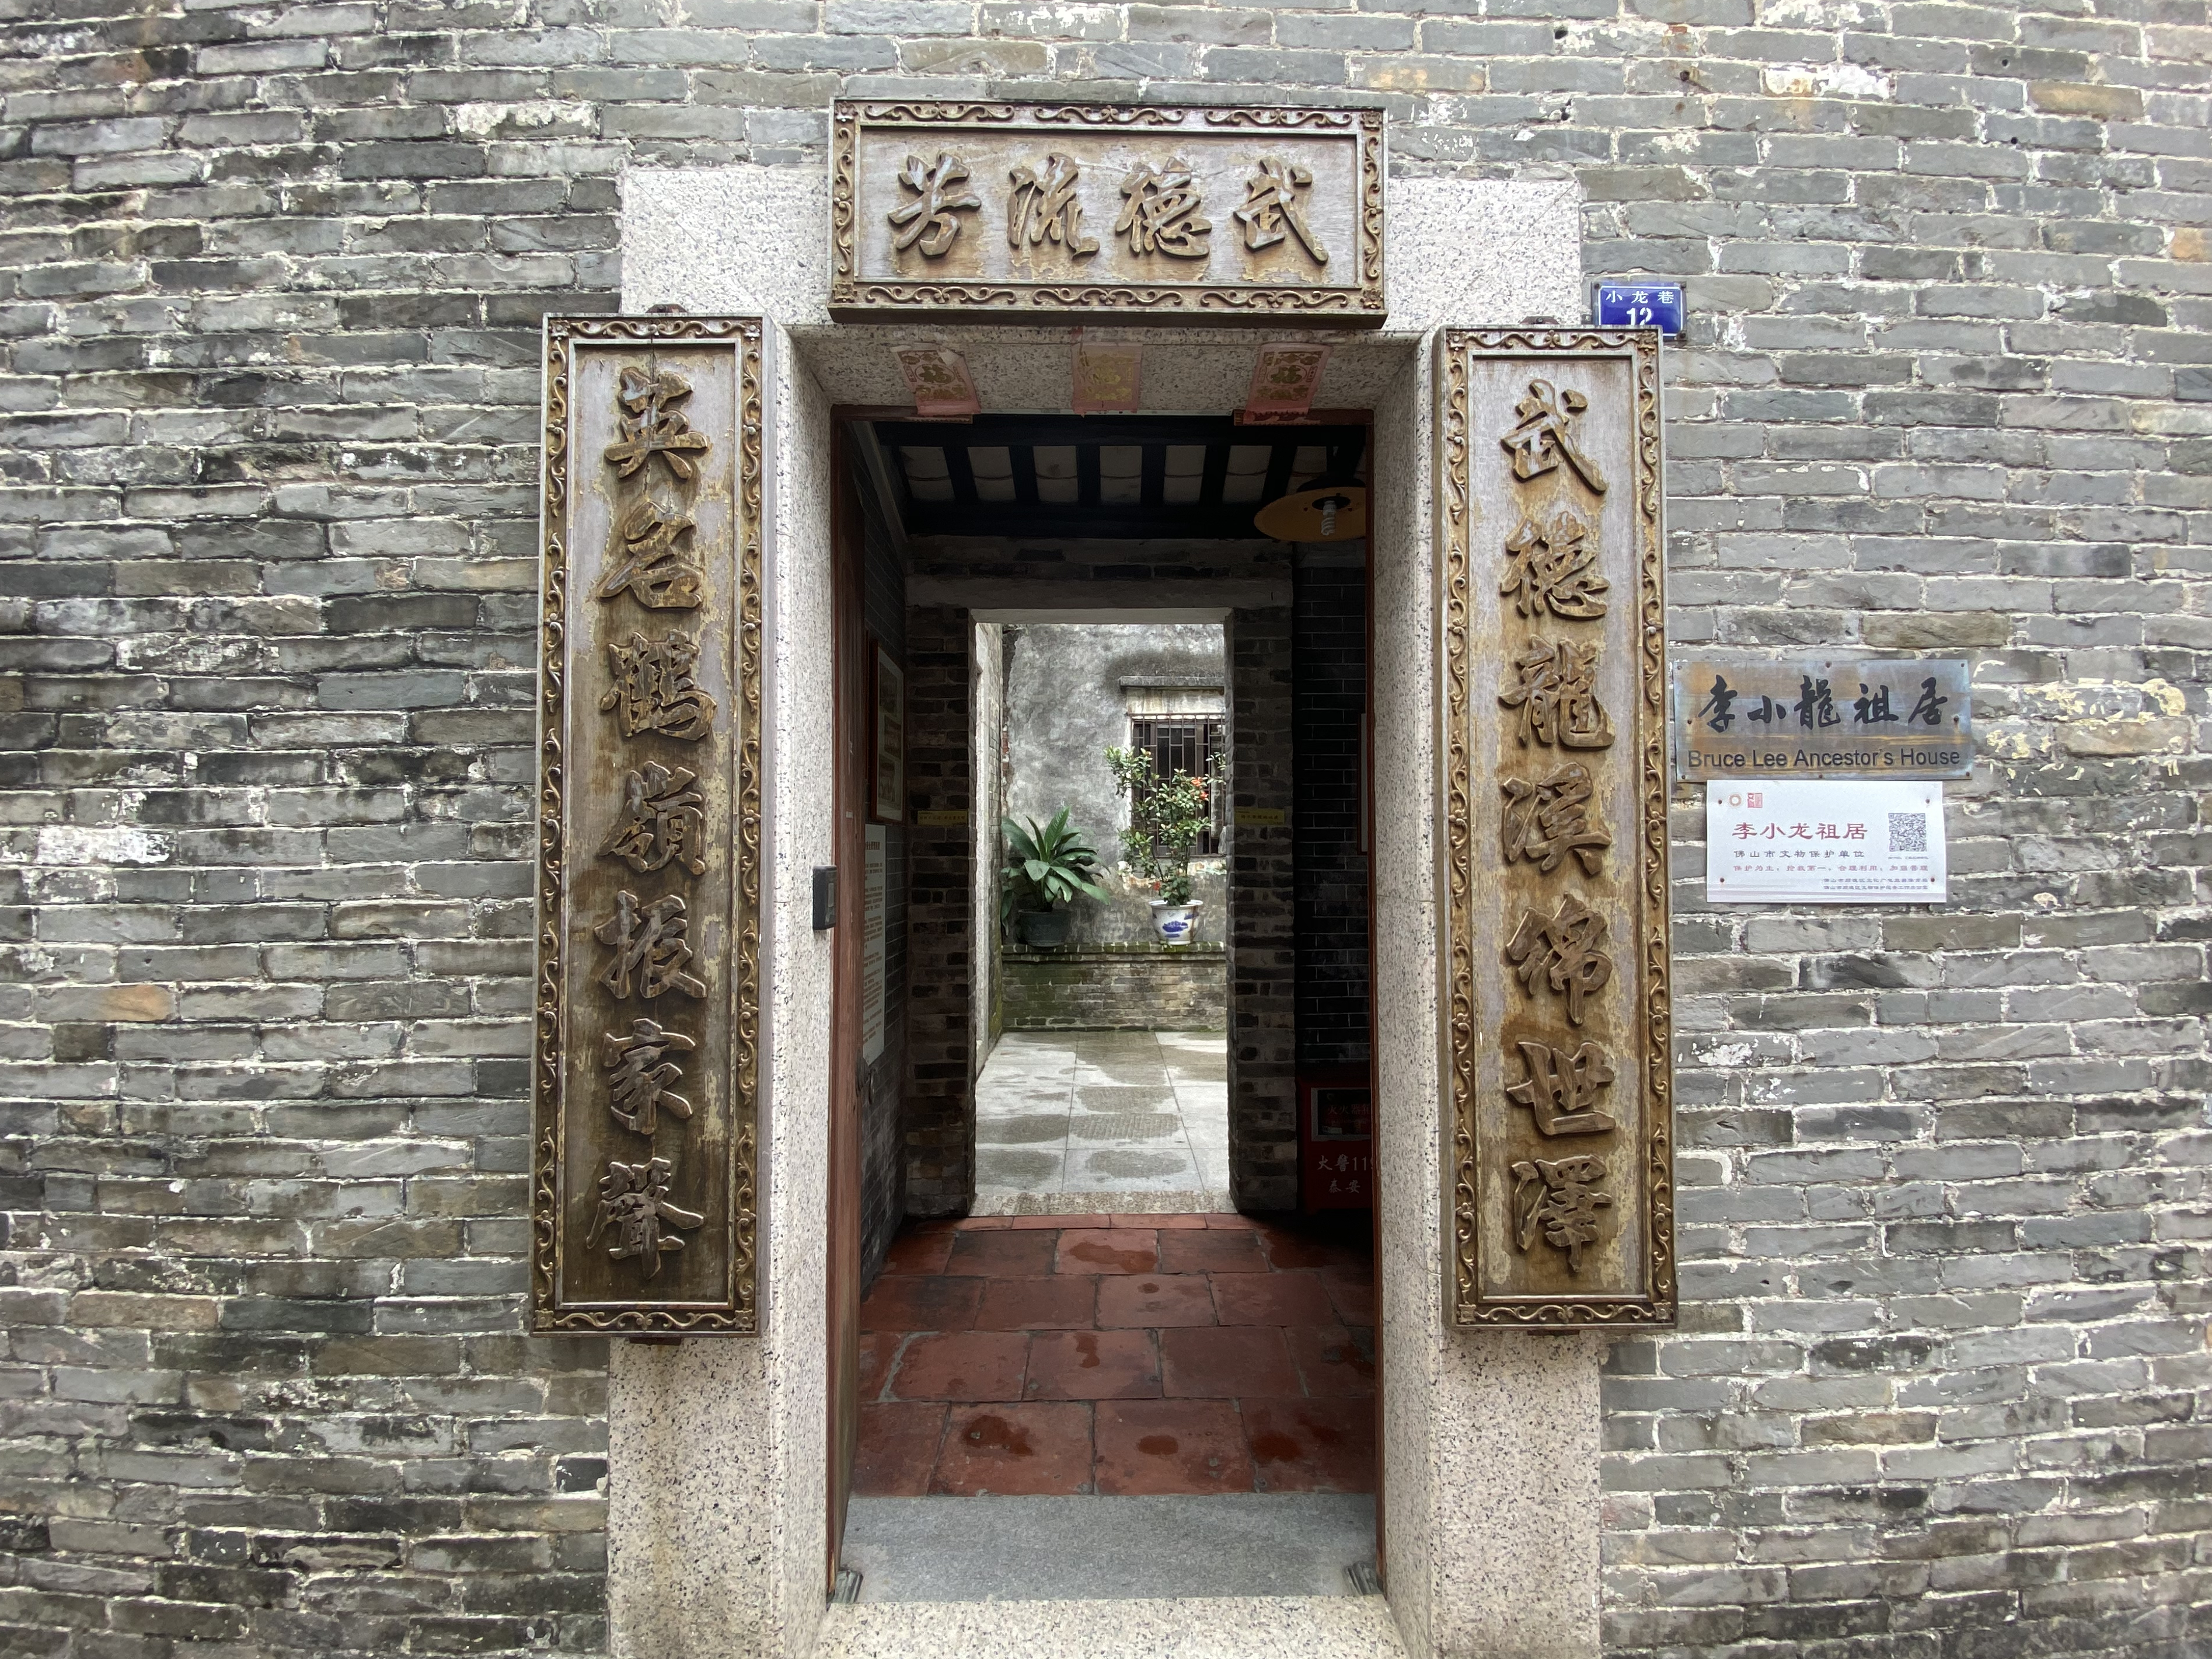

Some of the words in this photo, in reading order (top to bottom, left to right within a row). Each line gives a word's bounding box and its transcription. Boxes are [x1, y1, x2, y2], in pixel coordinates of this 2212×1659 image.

[1606, 290, 1674, 303] 小龙巷
[1626, 307, 1653, 325] 12
[1698, 675, 1948, 734] 李小龍祖居
[1687, 749, 1745, 768] Bruce
[1752, 749, 1788, 767] Lee
[1794, 749, 1893, 767] Ancestor's
[1901, 748, 1960, 766] House
[1732, 822, 1868, 840] 李小龙祖居
[1733, 850, 1865, 858] 佛山市文物保护单位
